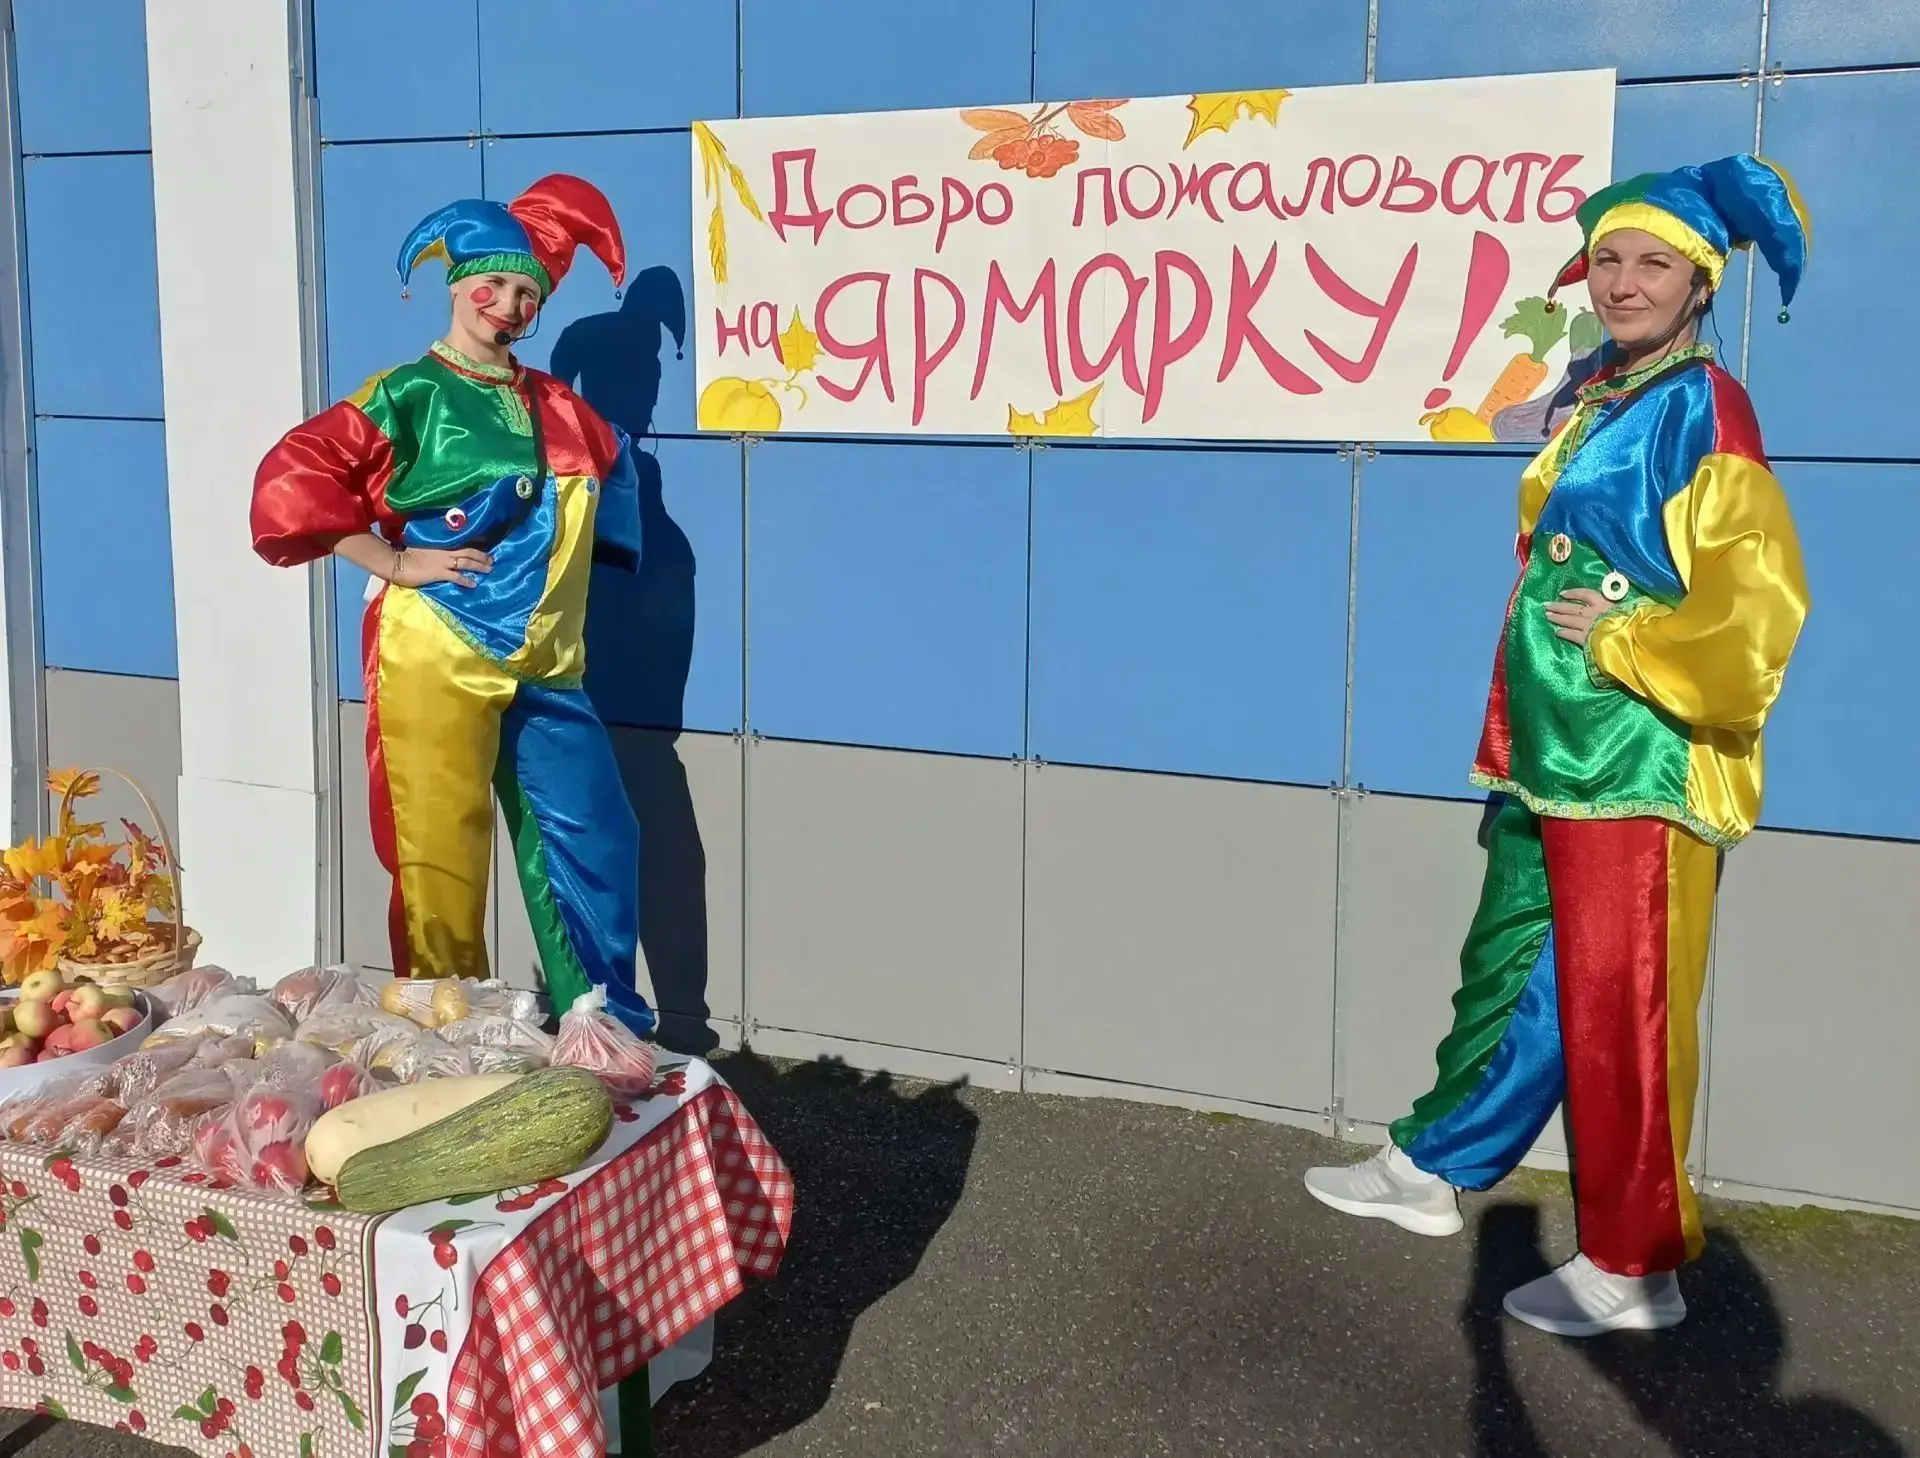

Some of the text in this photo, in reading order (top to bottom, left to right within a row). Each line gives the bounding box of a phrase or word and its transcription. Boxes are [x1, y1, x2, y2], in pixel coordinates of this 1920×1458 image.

[768, 148, 1588, 254] Добро пожаловать
[715, 300, 785, 364] на
